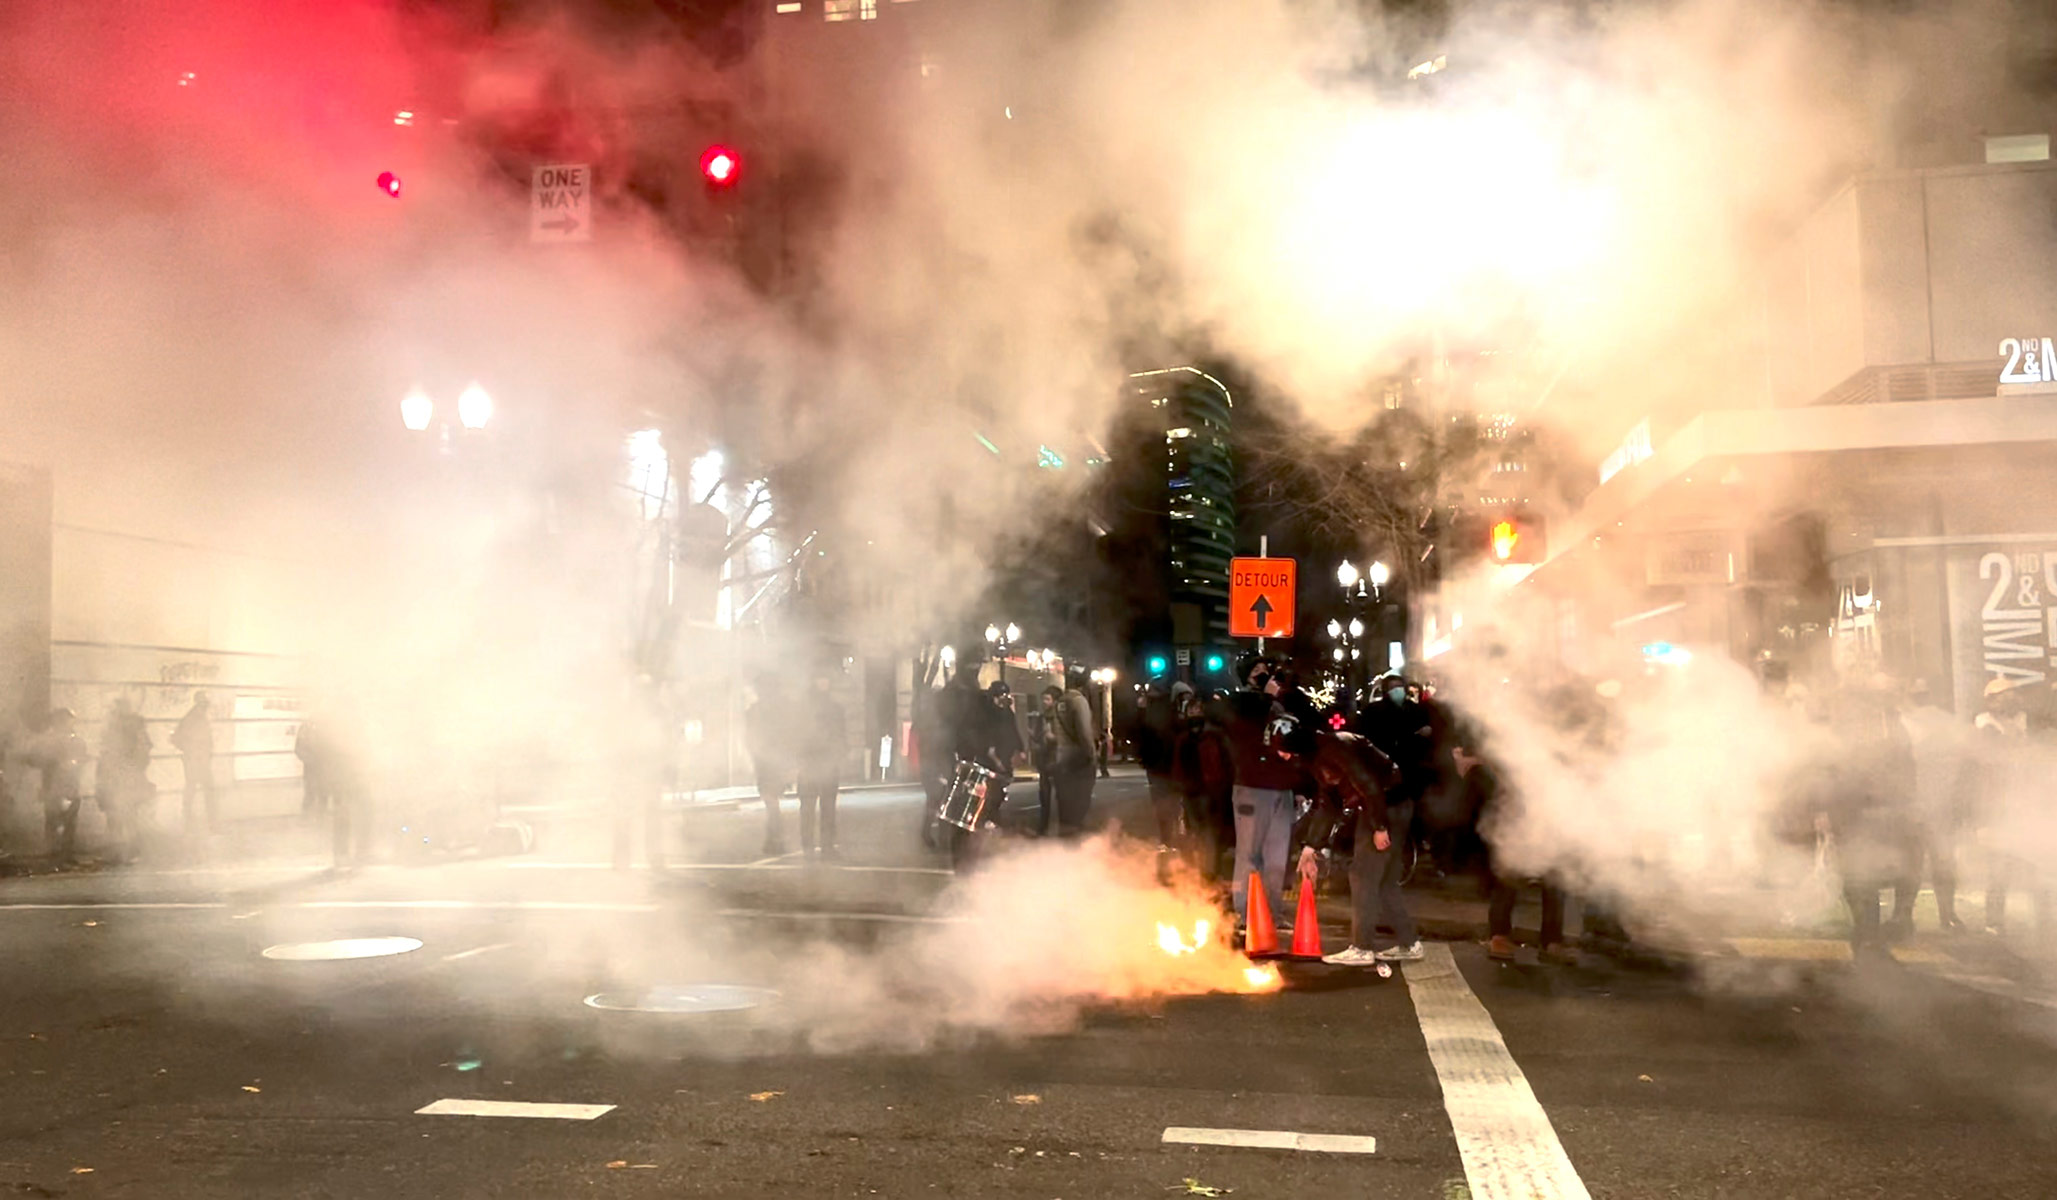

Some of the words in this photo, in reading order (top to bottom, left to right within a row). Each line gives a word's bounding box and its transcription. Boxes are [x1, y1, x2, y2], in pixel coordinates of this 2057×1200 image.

[541, 168, 582, 188] ONE
[540, 189, 583, 209] WAY
[1235, 572, 1288, 588] DETOUR
